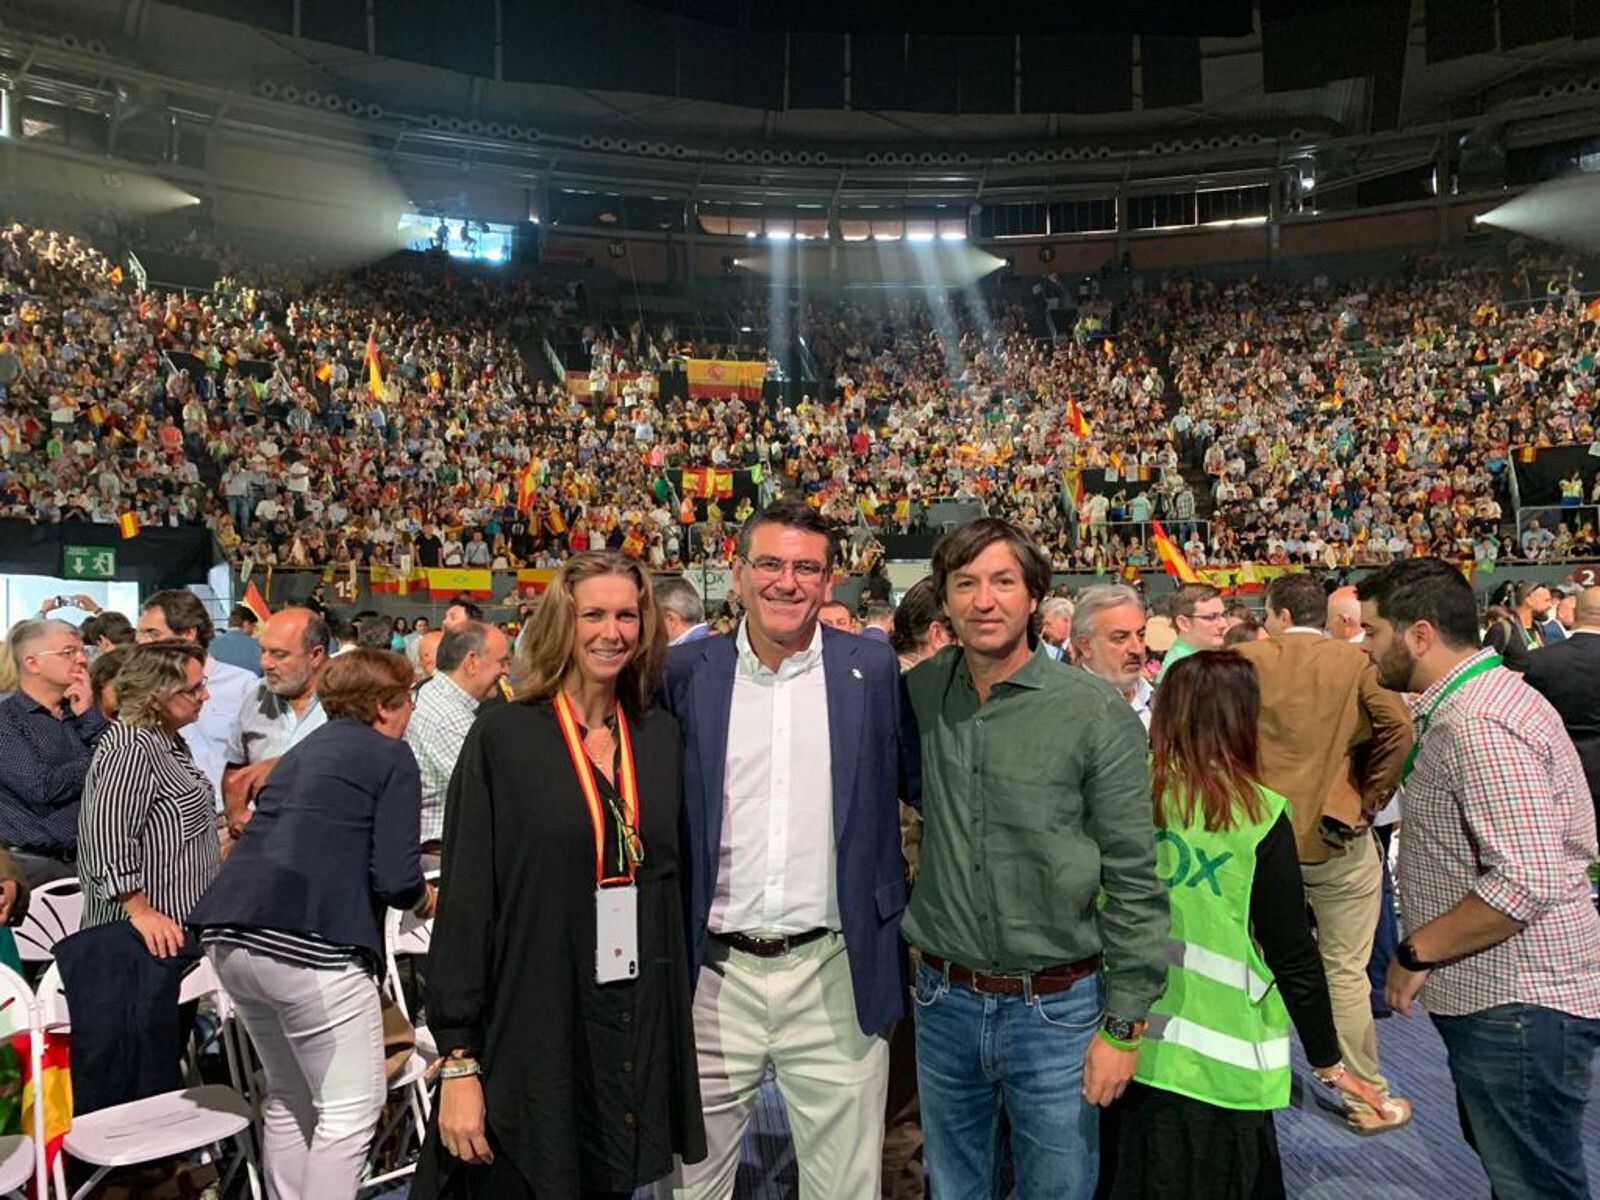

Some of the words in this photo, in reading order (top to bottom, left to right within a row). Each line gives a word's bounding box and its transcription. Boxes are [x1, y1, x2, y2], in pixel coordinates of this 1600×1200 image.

[610, 243, 625, 254] 16
[695, 571, 725, 585] VOX
[1582, 569, 1596, 586] 2
[1153, 830, 1235, 898] OX
